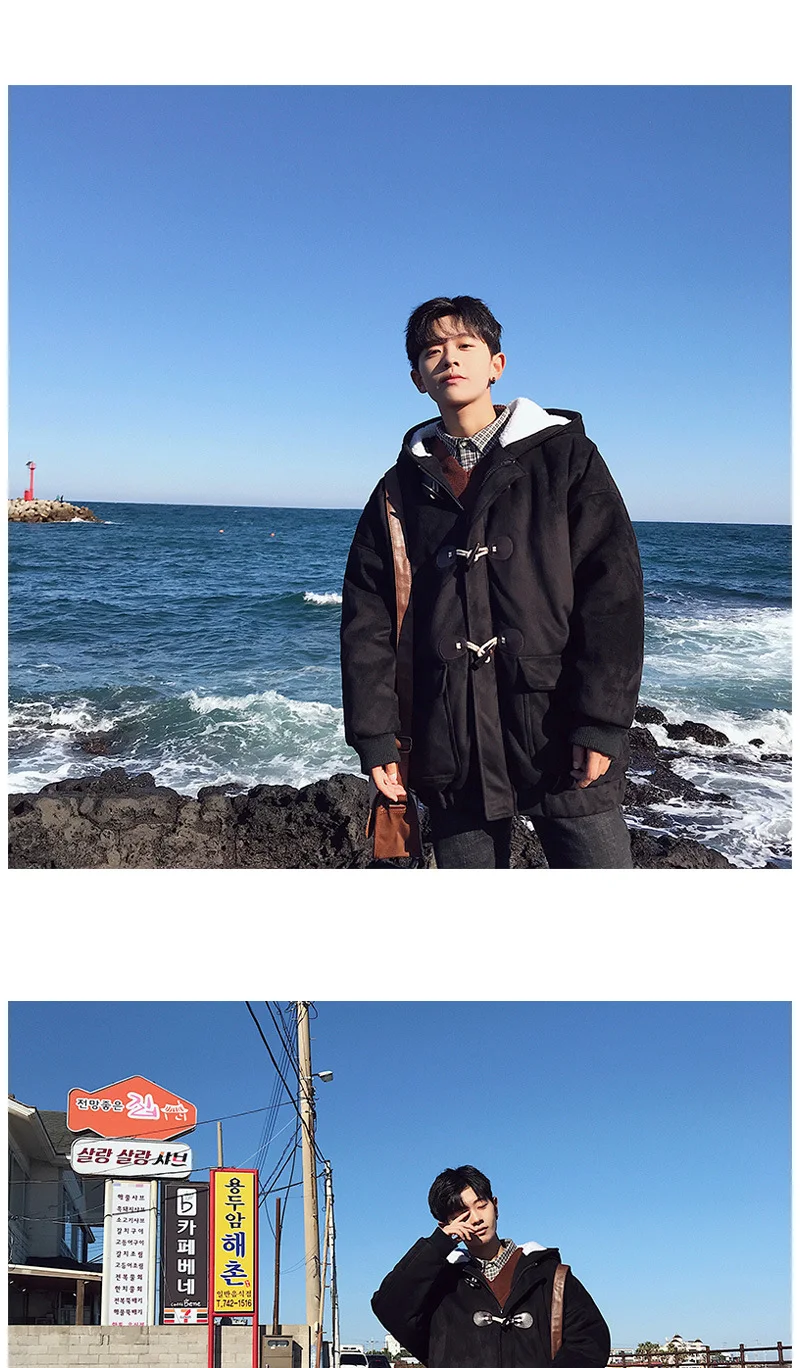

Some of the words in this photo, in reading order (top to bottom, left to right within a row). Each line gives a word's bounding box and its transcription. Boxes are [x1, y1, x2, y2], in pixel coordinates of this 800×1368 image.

[76, 1097, 124, 1112] 전망좋은
[77, 1147, 113, 1164] 살랑
[116, 1149, 151, 1165] 살랑
[152, 1151, 188, 1167] 샤브
[224, 1177, 246, 1229] 용두암
[177, 1220, 197, 1295] 카페베네
[220, 1232, 247, 1286] 해촌
[217, 1290, 252, 1298] 일반음식점
[217, 1299, 252, 1308] T.742-1516
